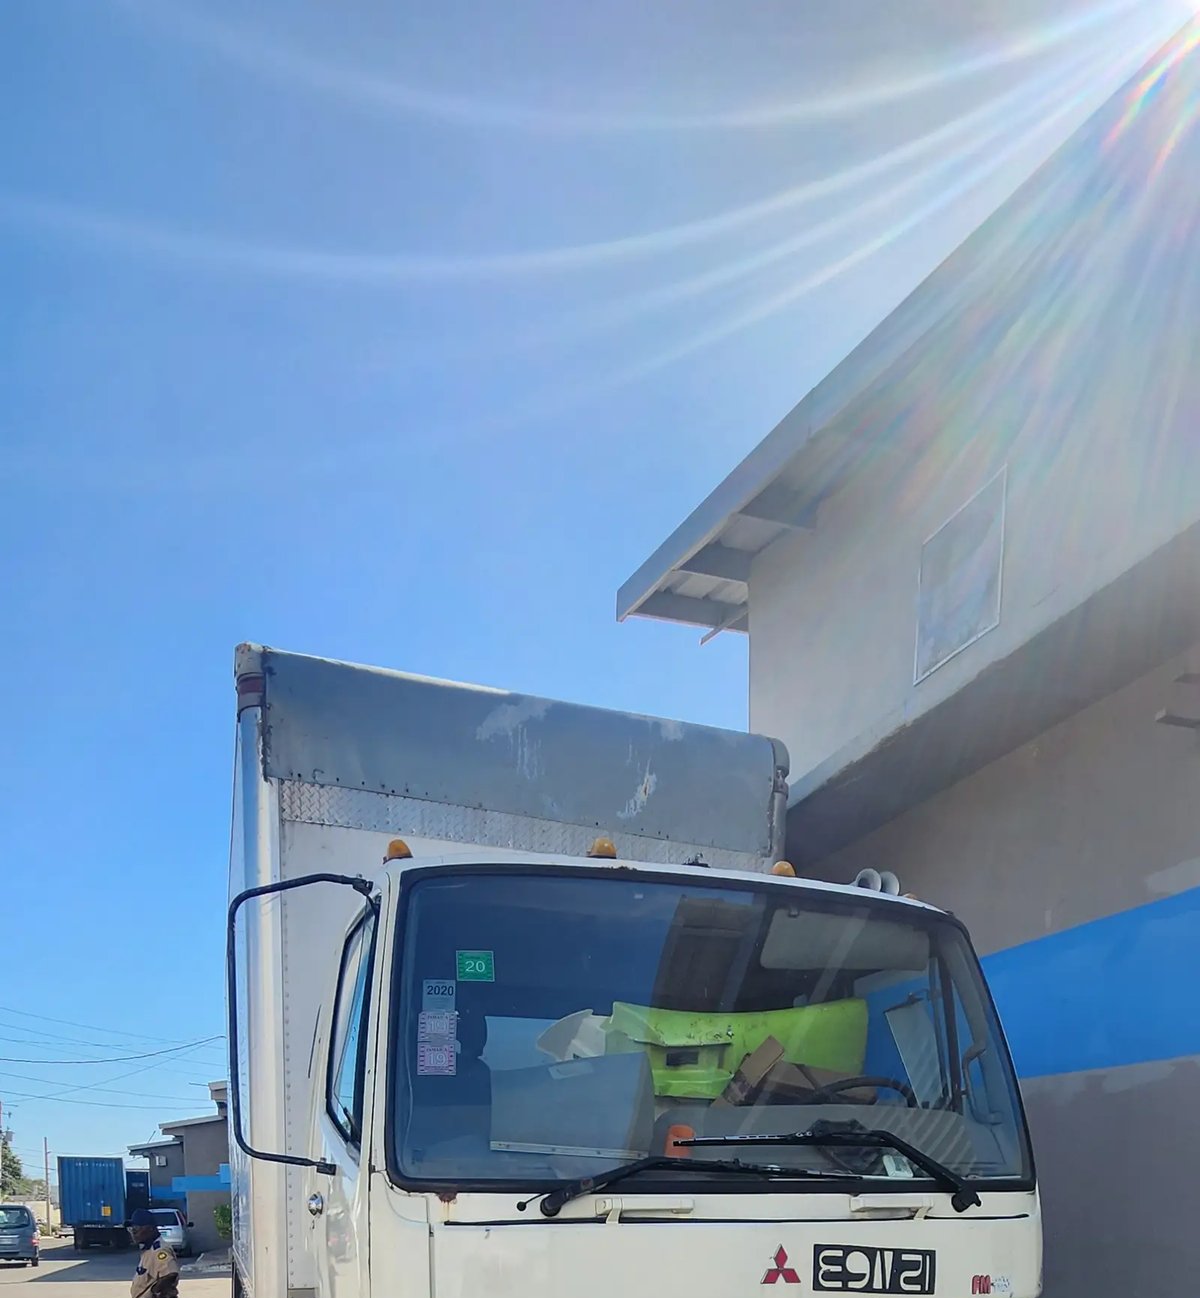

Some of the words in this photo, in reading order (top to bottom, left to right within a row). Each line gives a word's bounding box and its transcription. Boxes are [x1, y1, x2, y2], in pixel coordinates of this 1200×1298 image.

[465, 960, 486, 973] 20
[427, 985, 454, 996] 2020
[428, 1053, 447, 1066] 19
